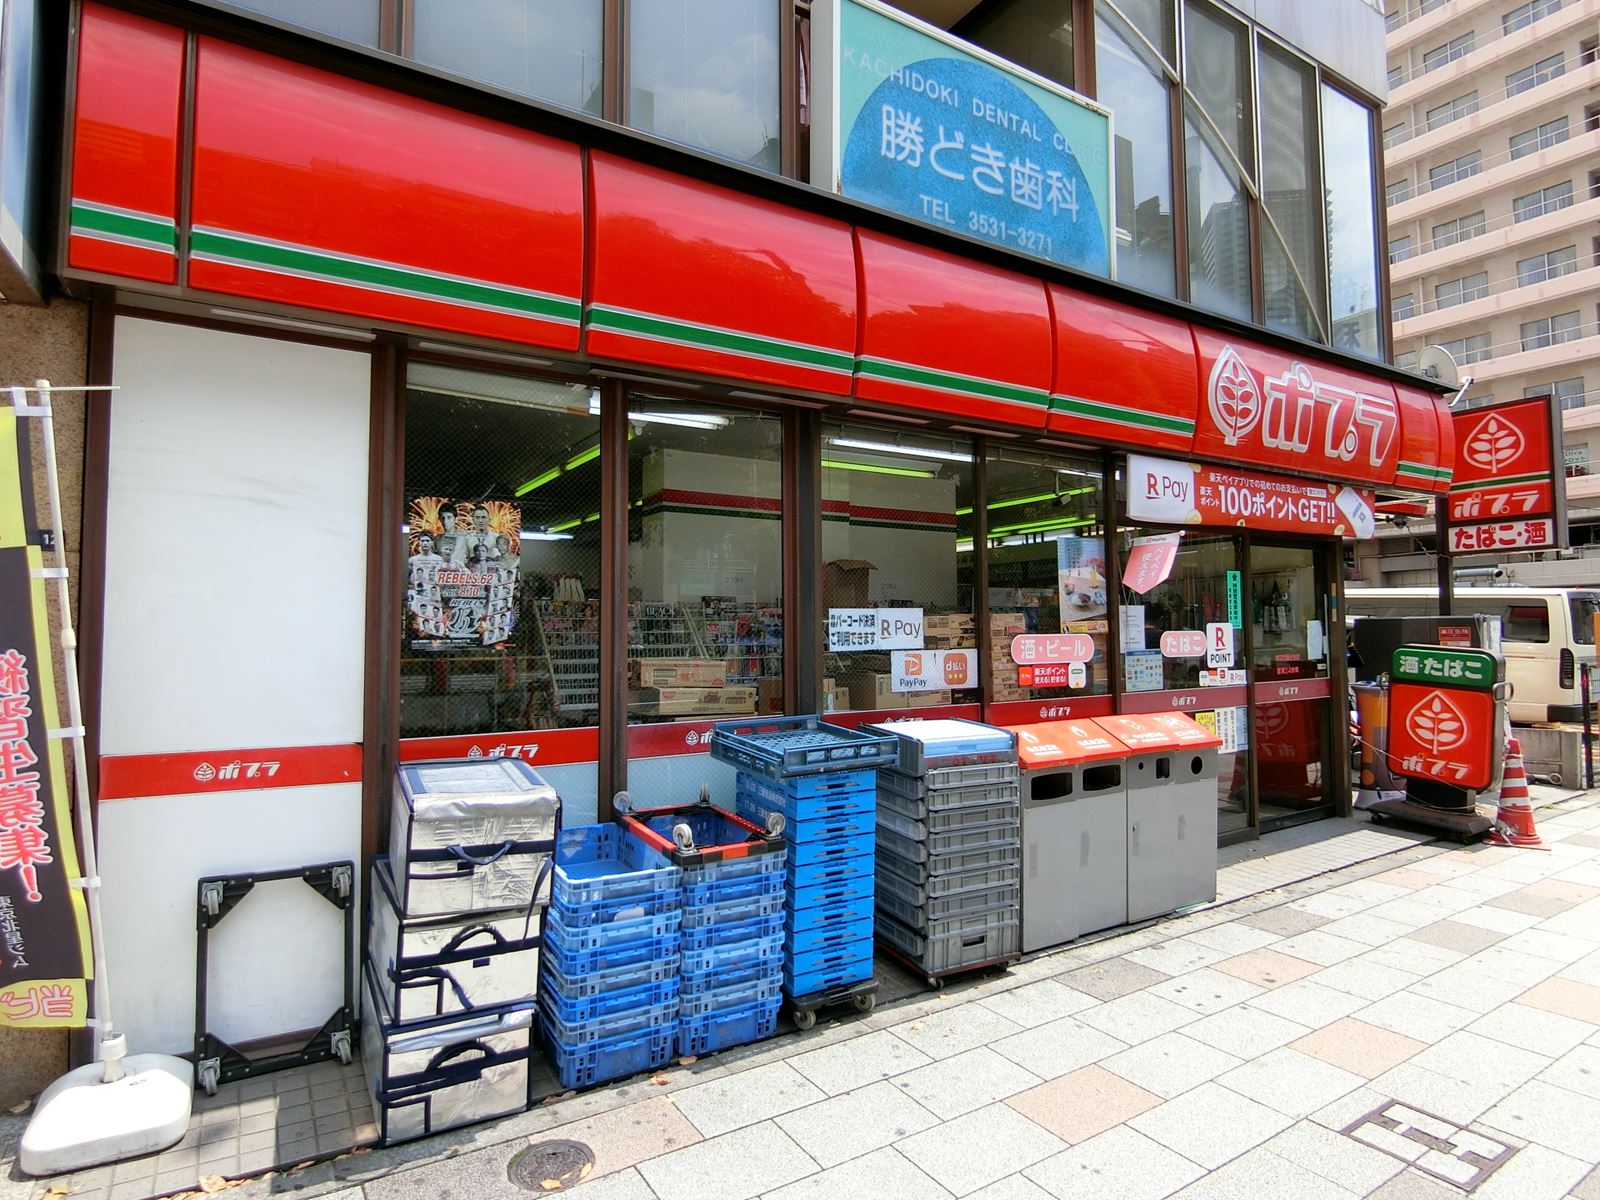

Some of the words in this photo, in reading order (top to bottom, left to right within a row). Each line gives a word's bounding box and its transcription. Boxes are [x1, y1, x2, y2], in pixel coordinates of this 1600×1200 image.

[845, 47, 958, 108] KACHIDOKI
[972, 98, 1041, 142] DENTAL
[880, 104, 1080, 223] 勝どき歯科
[920, 194, 955, 225] TEL
[968, 210, 1053, 252] 3531-3271
[1263, 361, 1397, 467] ポプラ
[1146, 472, 1158, 497] R
[1162, 475, 1188, 503] Pay
[1200, 497, 1220, 508] ポイント
[1218, 484, 1335, 524] 100ポイントGET!!
[1454, 490, 1540, 518] ポプラ
[1455, 522, 1546, 549] たばこ・酒
[438, 571, 493, 584] REBELS.62
[831, 632, 876, 646] ご利用できます
[881, 619, 891, 636] R
[895, 620, 921, 639] Pay
[1215, 627, 1225, 647] R
[1020, 639, 1086, 659] 酒・ビール
[1210, 653, 1231, 663] POINT
[900, 678, 928, 688] PayPay
[1048, 706, 1071, 717] ポプラ
[489, 743, 539, 758] ポプラ
[218, 760, 281, 780] ポプラ
[1402, 752, 1470, 780] ポプラ
